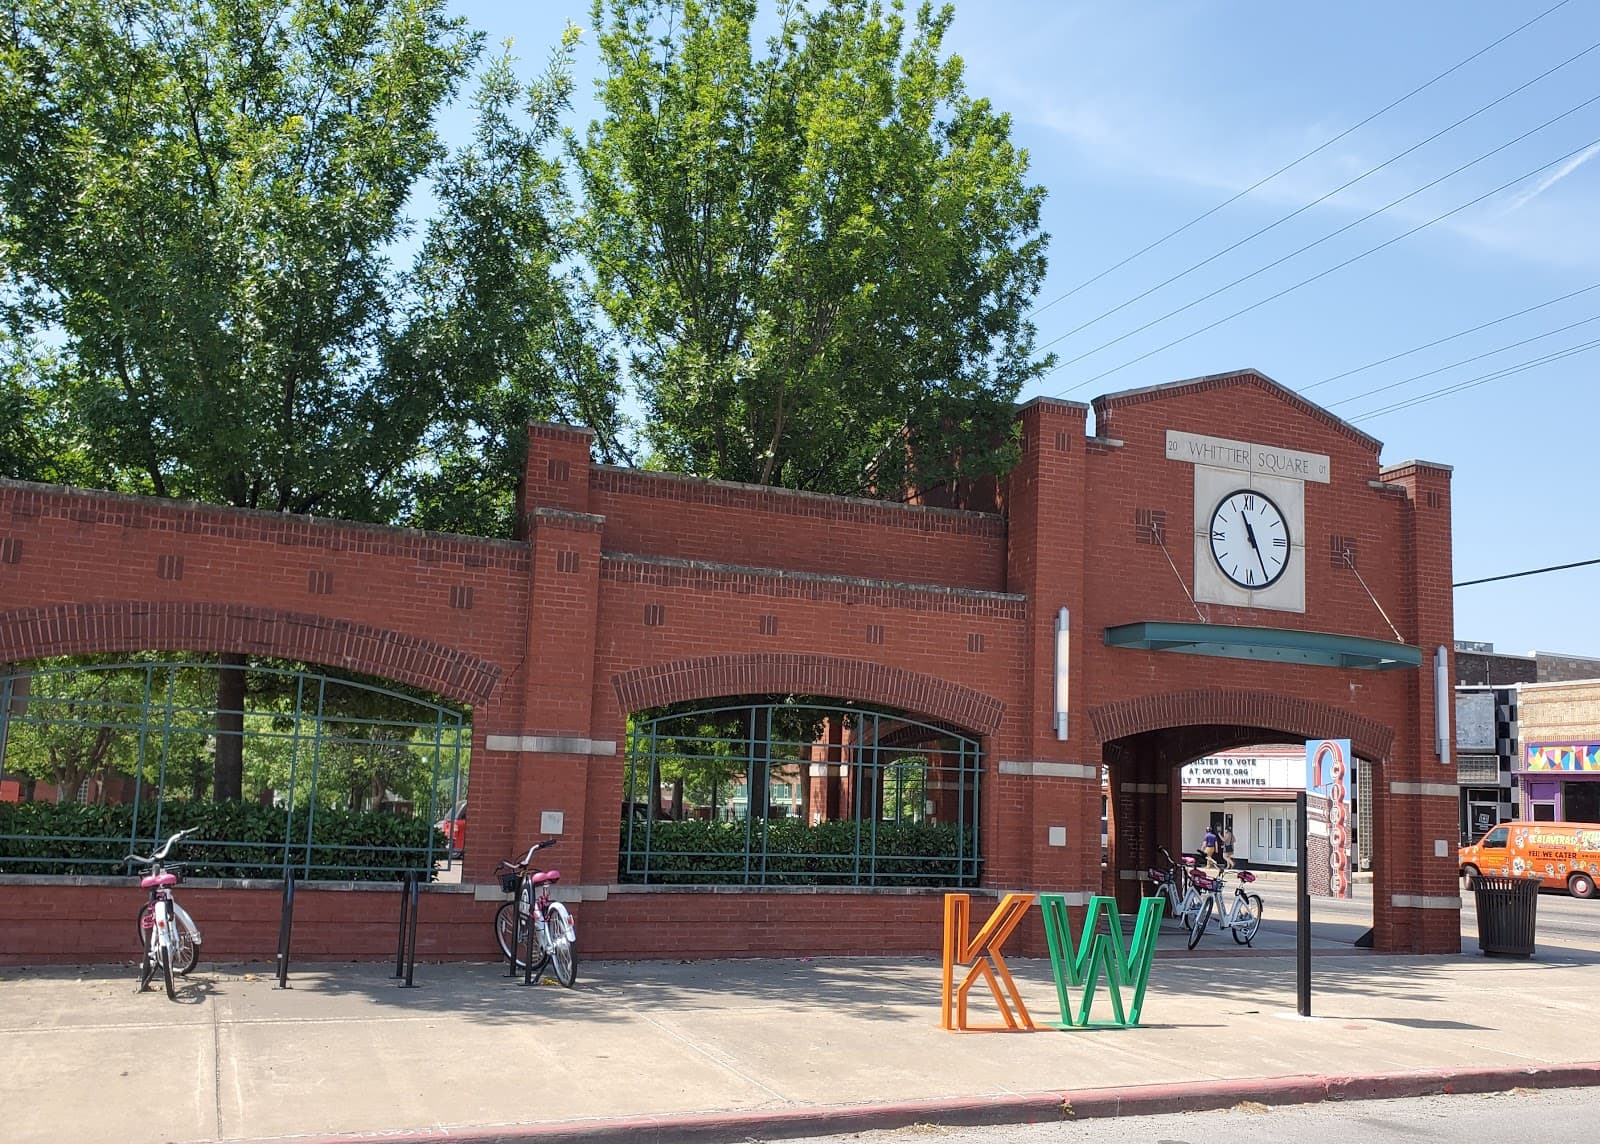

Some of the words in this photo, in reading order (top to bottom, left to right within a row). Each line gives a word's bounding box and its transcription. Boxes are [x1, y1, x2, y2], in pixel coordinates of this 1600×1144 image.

[1168, 440, 1178, 451] 20
[1188, 440, 1250, 465] WHITTIER
[1258, 452, 1309, 474] SQUARE
[1244, 495, 1254, 511] XII
[1223, 758, 1233, 766] TO
[1236, 758, 1257, 767] VOTE
[1188, 767, 1199, 775] AT
[1202, 767, 1249, 776] OKVOTE.ORG
[1196, 777, 1222, 785] TAKES
[1224, 777, 1230, 785] 2
[1231, 777, 1266, 786] MINUTES
[1542, 850, 1553, 858] WE
[1554, 851, 1577, 859] CATER
